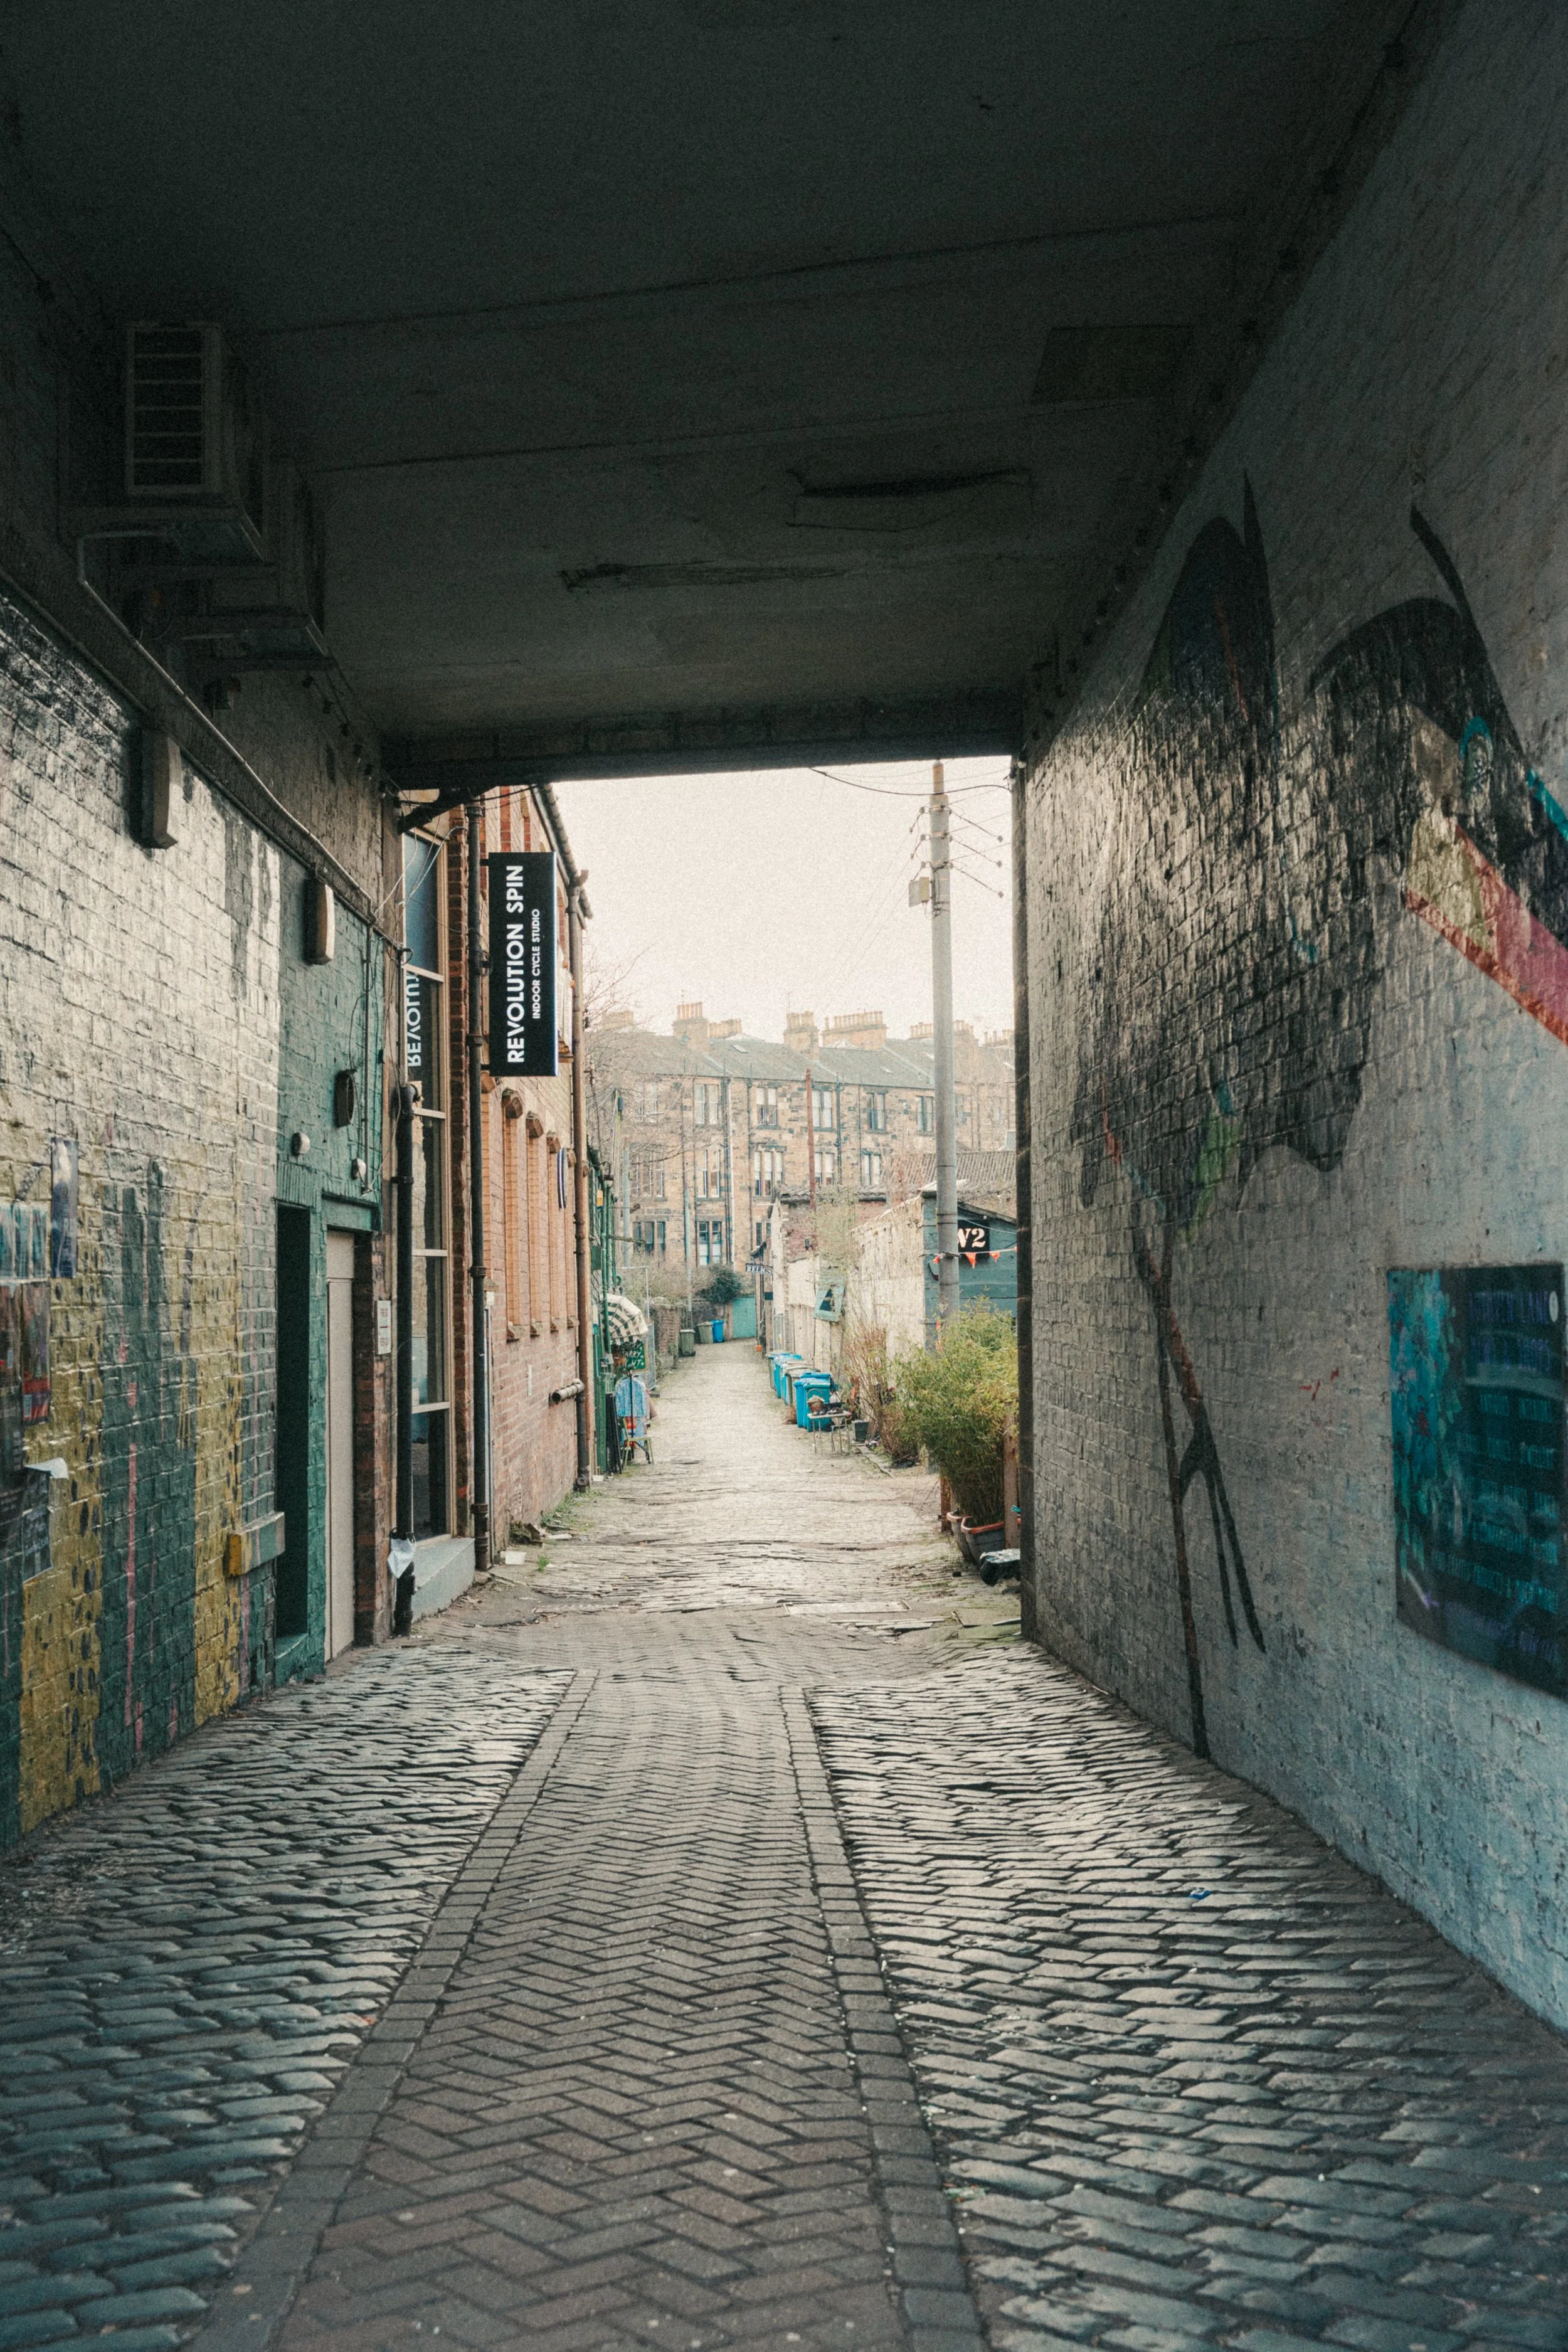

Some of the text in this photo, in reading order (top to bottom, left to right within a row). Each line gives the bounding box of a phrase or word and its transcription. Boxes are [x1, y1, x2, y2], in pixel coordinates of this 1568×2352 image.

[506, 865, 524, 1062] REVOLUTION SPIN
[531, 908, 541, 1019] INDOOR CYCLE STUDIO
[746, 1265, 773, 1275] RELICS
